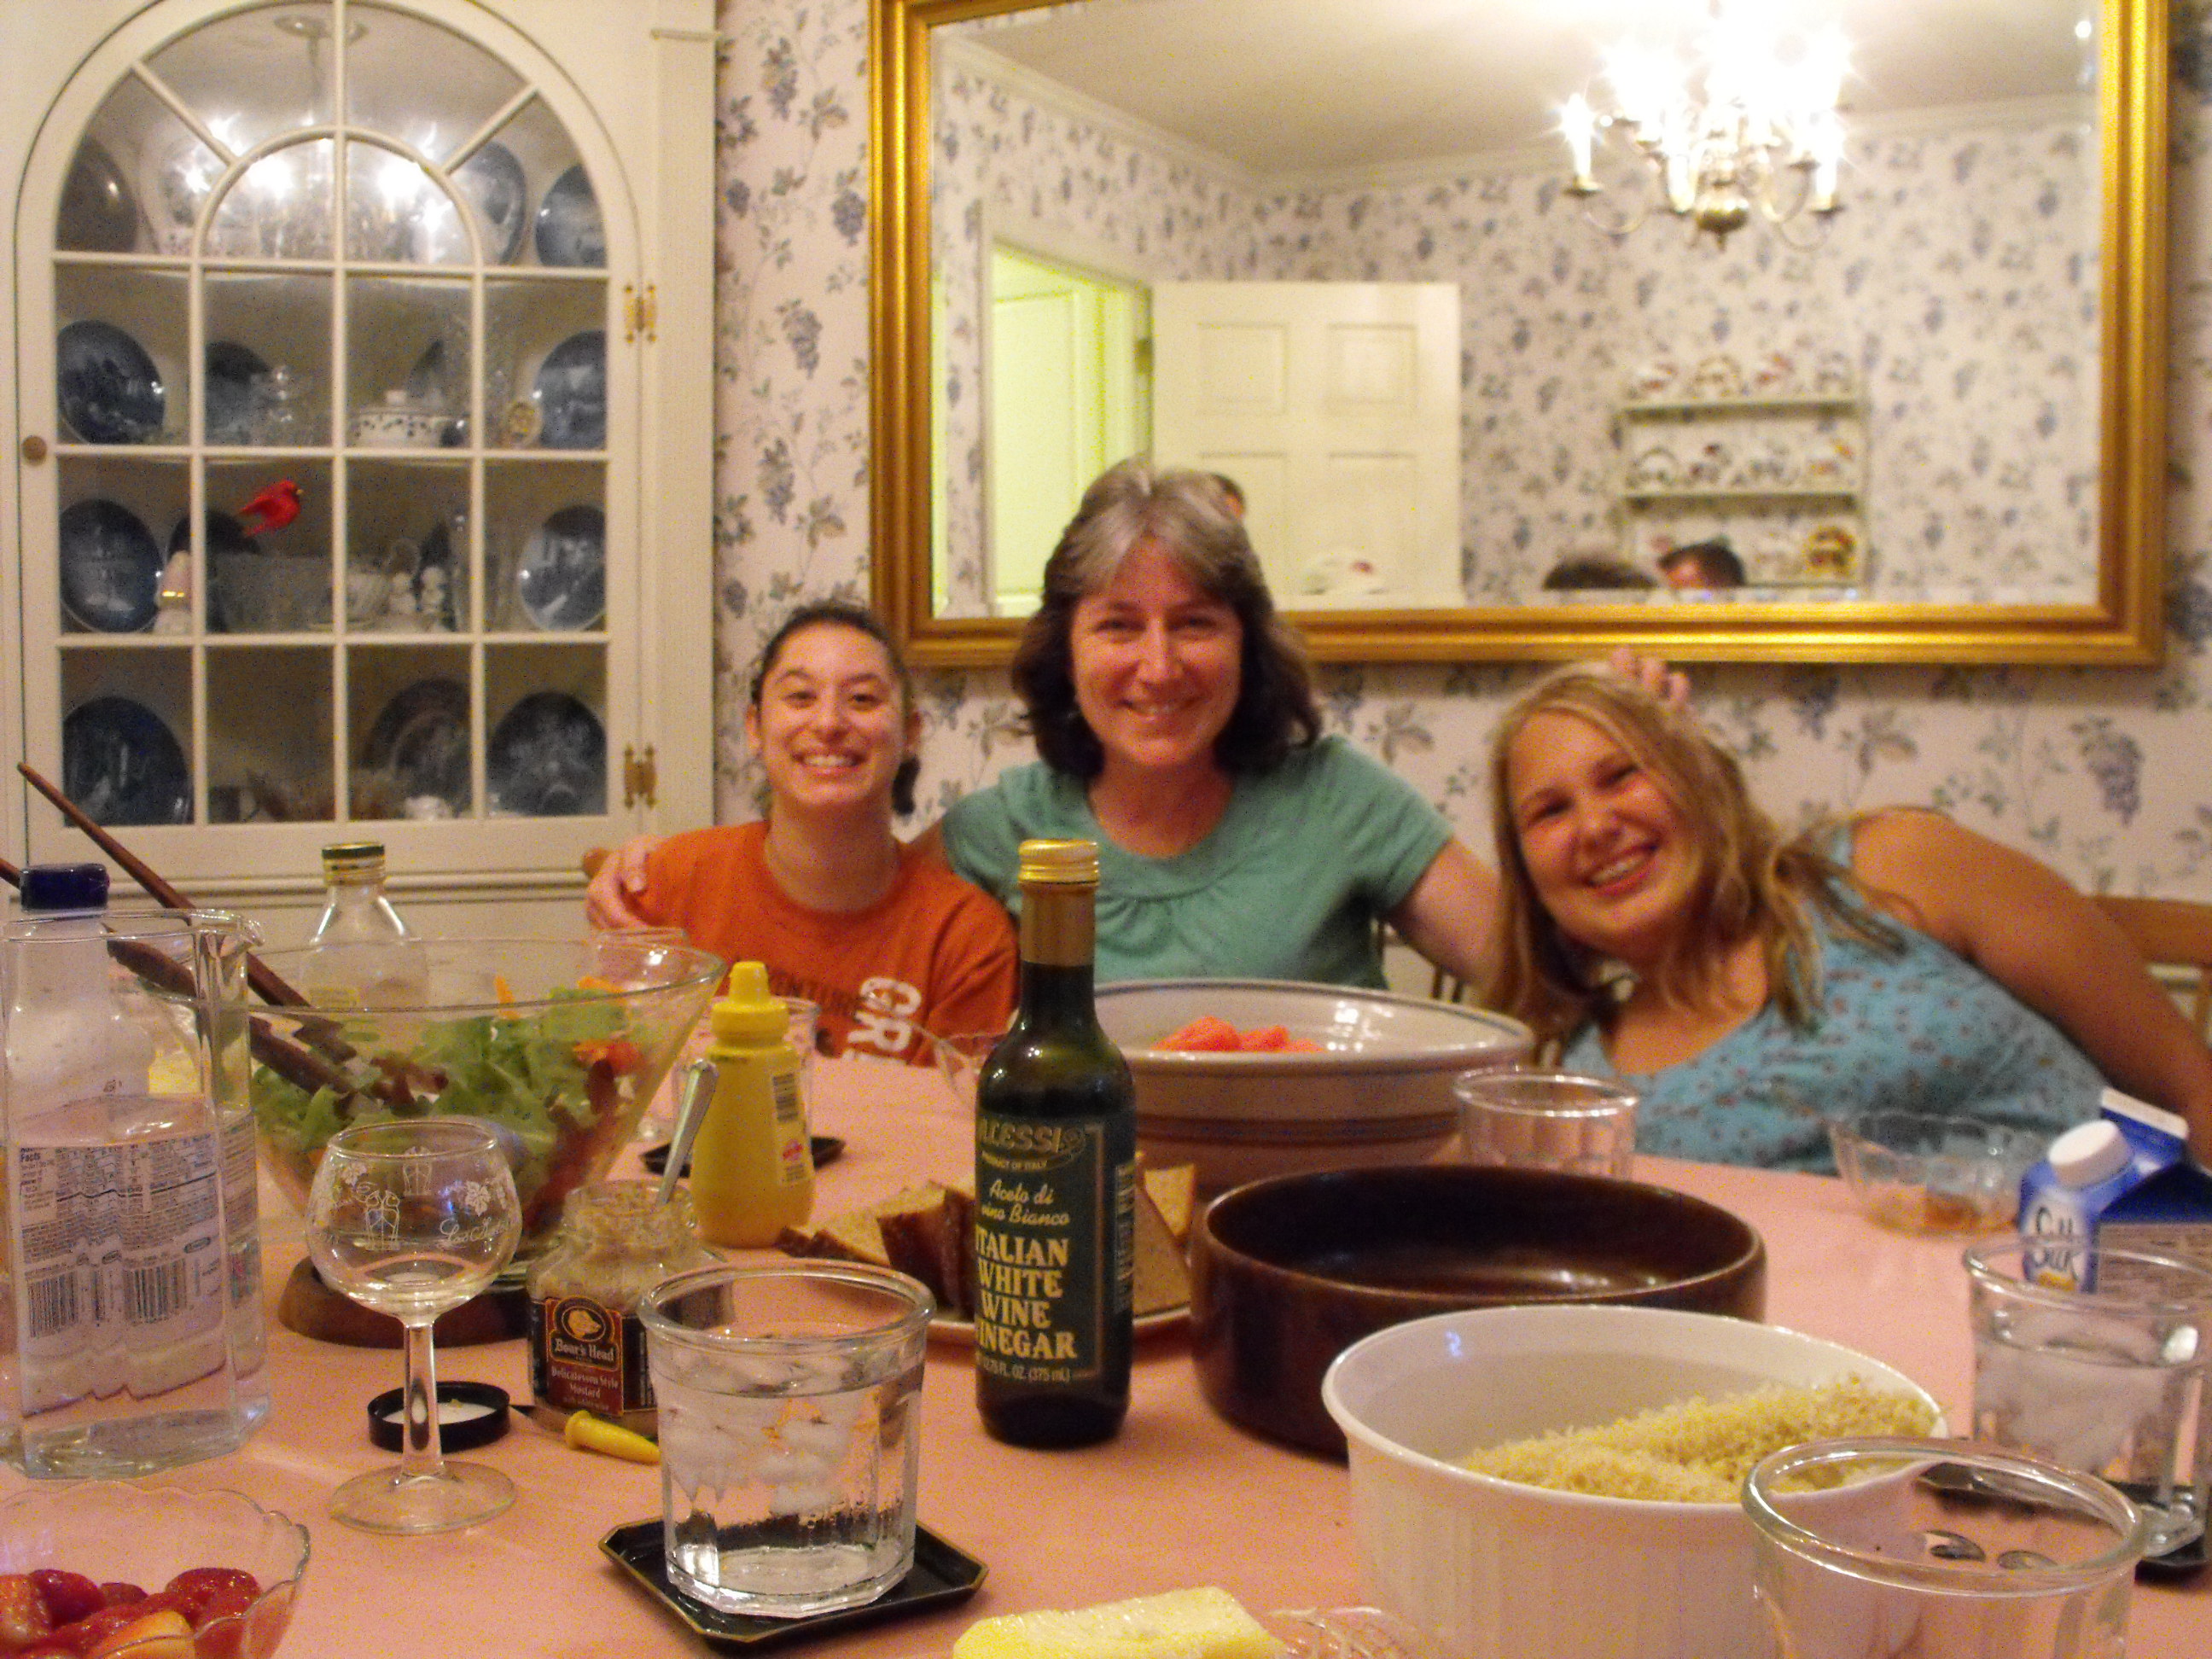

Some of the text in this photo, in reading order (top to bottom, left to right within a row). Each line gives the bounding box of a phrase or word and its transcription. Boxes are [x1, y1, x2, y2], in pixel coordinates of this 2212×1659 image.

[841, 975, 923, 1064] GR
[1033, 1183, 1055, 1205] di
[975, 1225, 1070, 1267] ITALIAN
[978, 1258, 1064, 1298] WHITE
[981, 1290, 1051, 1329] WINE
[588, 1343, 614, 1363] Head
[975, 1324, 1078, 1360] INEGAR
